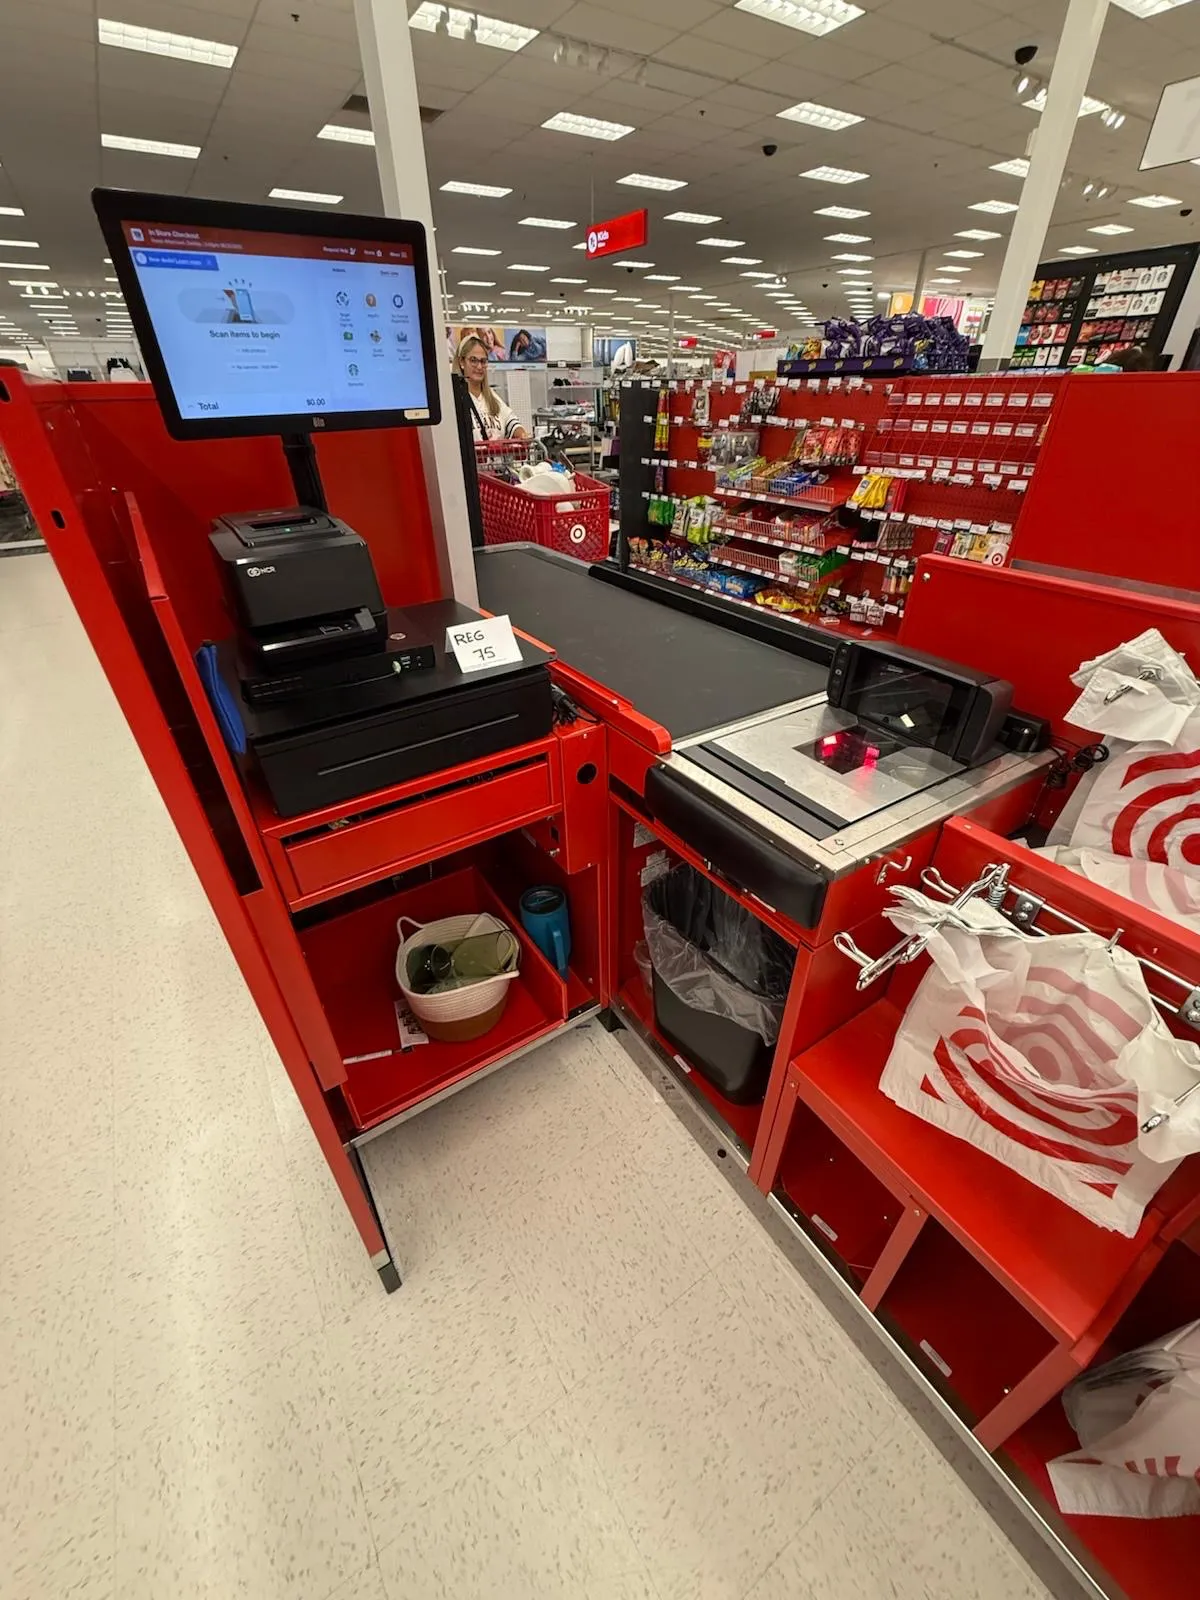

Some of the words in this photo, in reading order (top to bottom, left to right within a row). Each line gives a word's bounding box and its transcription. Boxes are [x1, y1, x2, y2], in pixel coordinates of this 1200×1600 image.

[598, 230, 609, 241] Kids
[209, 330, 229, 338] Scan
[230, 330, 251, 338] items
[260, 331, 281, 340] begin
[198, 402, 219, 411] Total
[306, 398, 326, 406] $0.00
[260, 566, 276, 574] NCR
[454, 630, 485, 646] REG
[472, 646, 496, 661] 75
